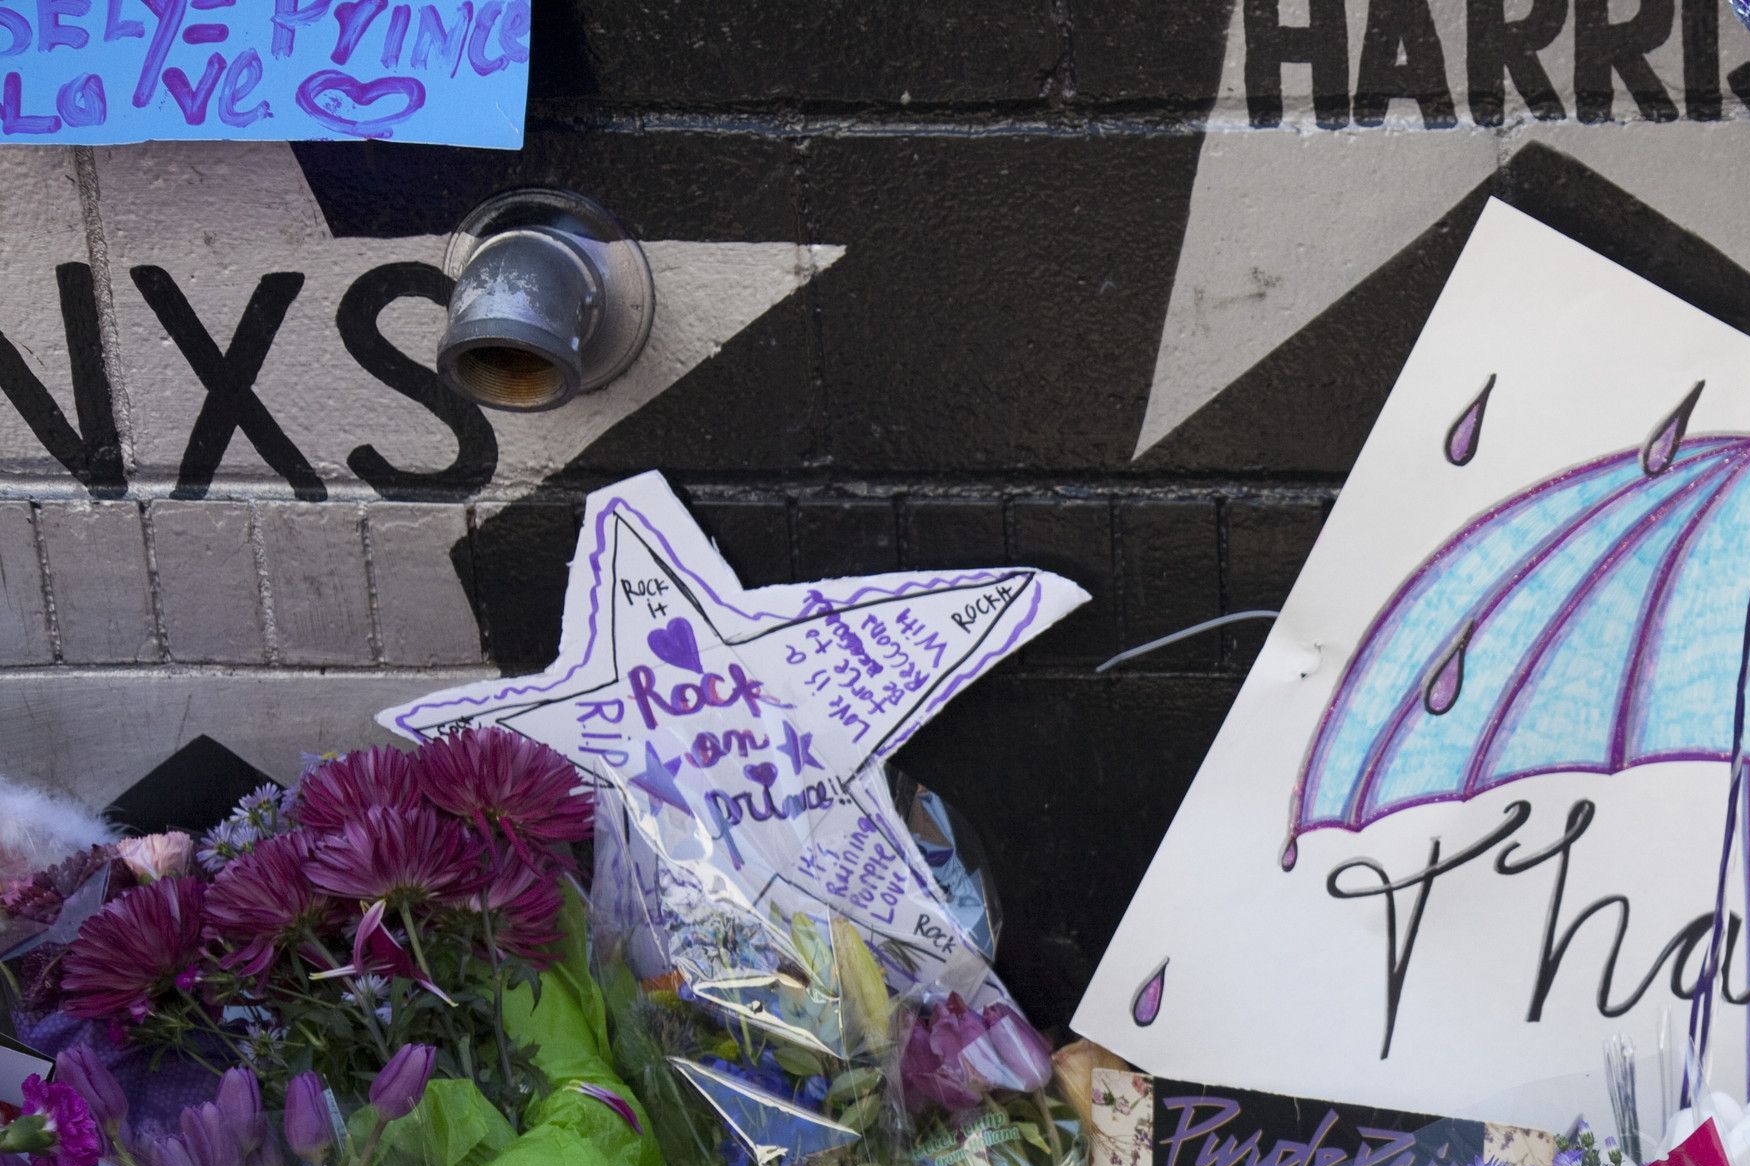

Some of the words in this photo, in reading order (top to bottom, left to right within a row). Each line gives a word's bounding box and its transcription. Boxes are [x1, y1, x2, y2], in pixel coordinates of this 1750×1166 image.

[786, 644, 806, 664] a
[806, 628, 833, 654] to
[685, 729, 770, 769] on
